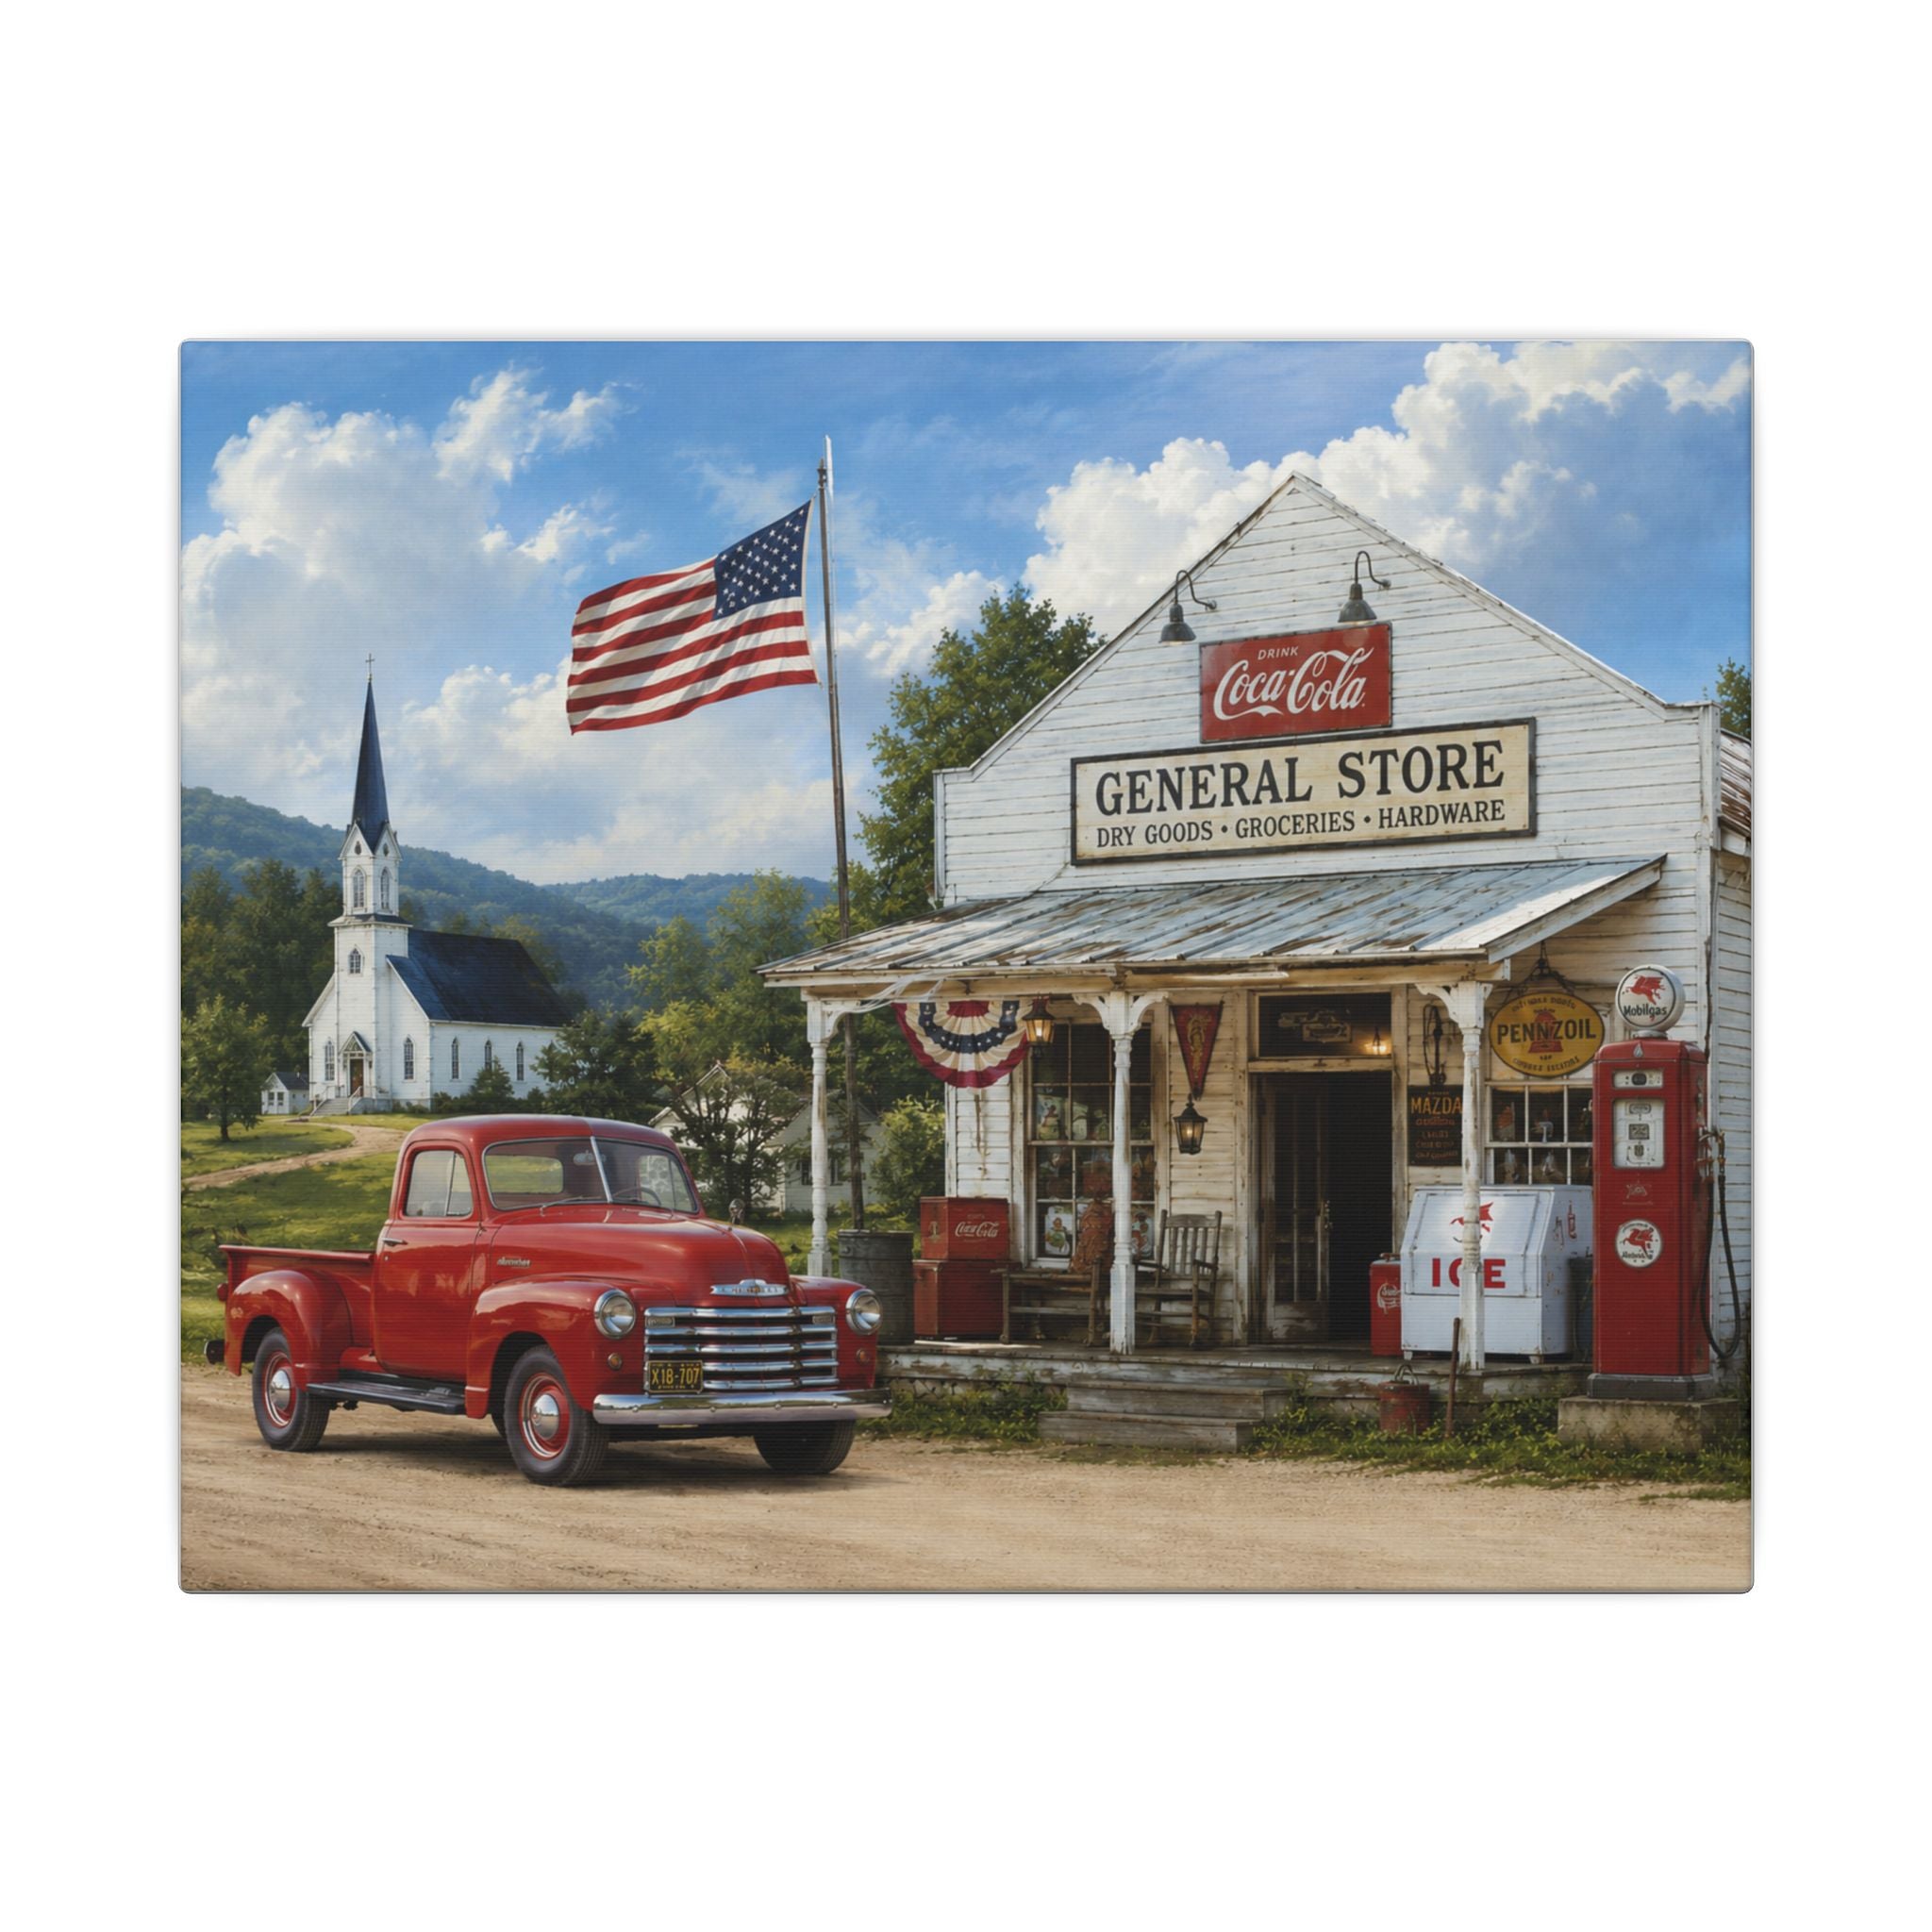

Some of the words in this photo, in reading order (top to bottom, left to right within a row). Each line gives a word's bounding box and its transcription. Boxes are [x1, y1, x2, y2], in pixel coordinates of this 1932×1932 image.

[1257, 646, 1299, 660] DRINK
[1213, 647, 1374, 721] Coca-Cola
[1095, 758, 1313, 816] GENERAL
[1338, 740, 1505, 798] STORE
[1097, 825, 1136, 848] DRY
[1144, 821, 1213, 844] GOODS
[1235, 810, 1356, 839] GROCERIES
[1378, 799, 1506, 829] HARDWARE
[1624, 1004, 1668, 1021] Mobilgas
[1497, 1018, 1596, 1045] PENNZOIL
[1411, 1096, 1464, 1114] MAZDA
